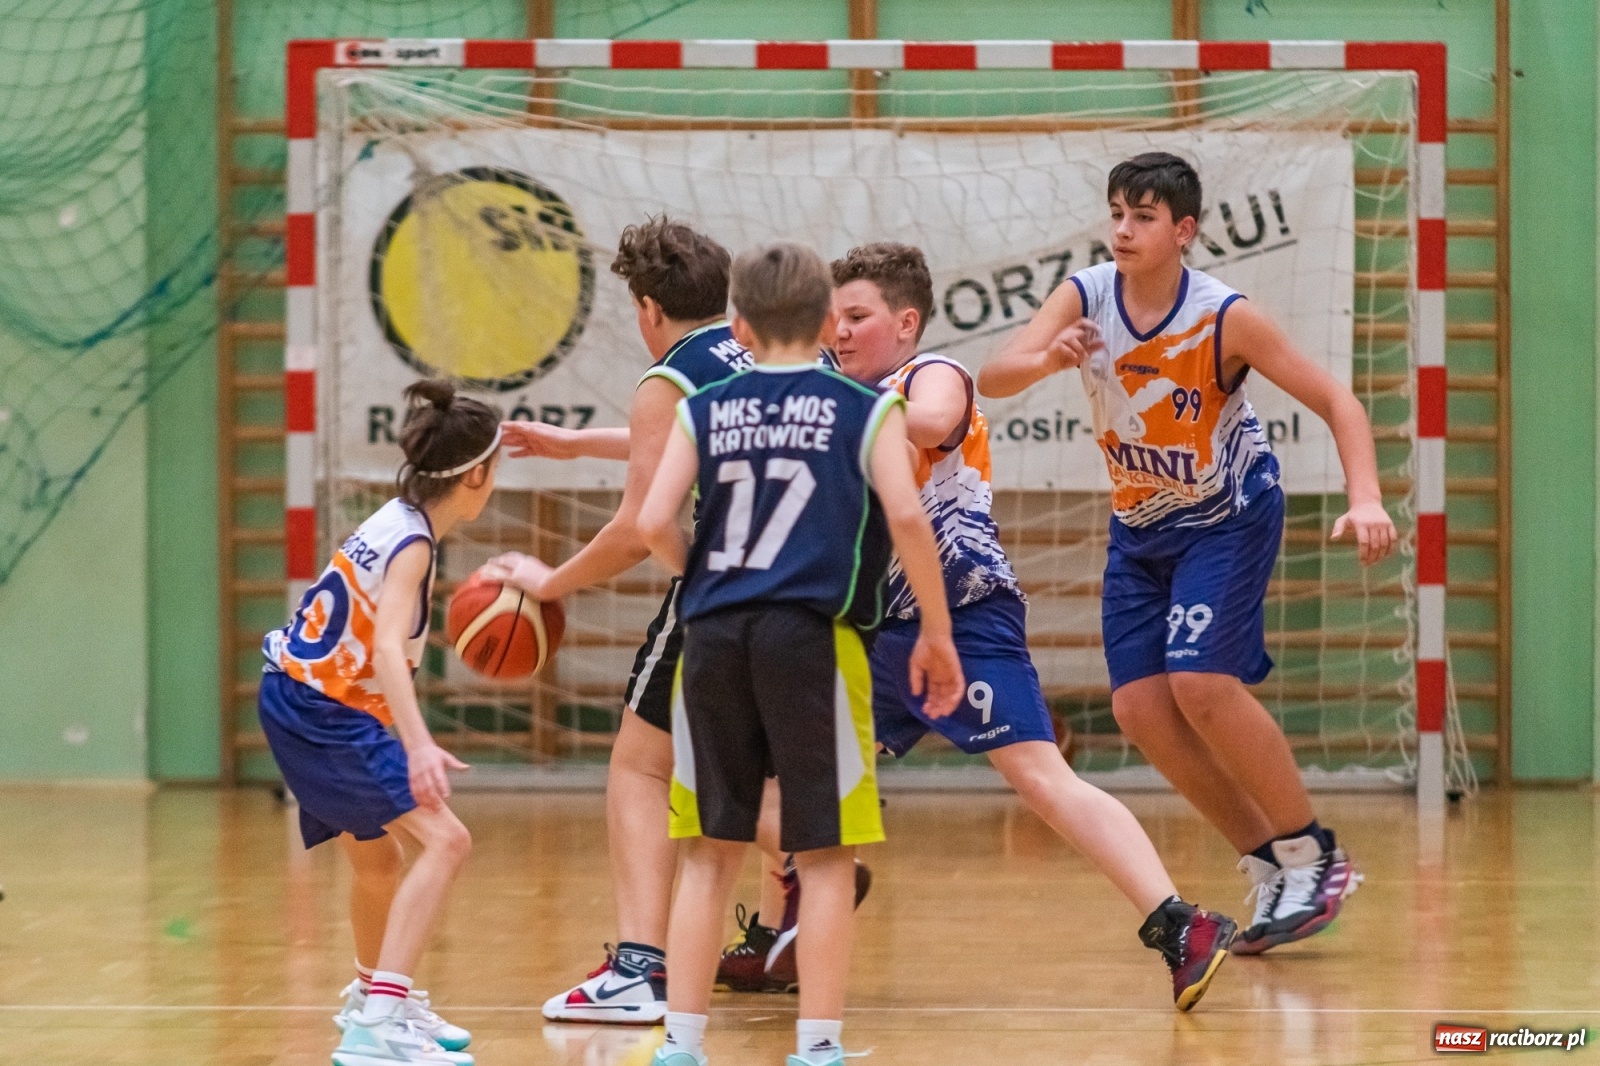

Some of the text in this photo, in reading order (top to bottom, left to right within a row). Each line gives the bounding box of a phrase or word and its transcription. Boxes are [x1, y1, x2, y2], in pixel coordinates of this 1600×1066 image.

[709, 397, 763, 431] MKS
[781, 394, 837, 426] MOS
[1171, 386, 1203, 423] 99
[709, 423, 833, 457] KATOWICE
[1105, 441, 1198, 485] MINI
[707, 458, 818, 572] 17
[1165, 603, 1213, 645] 99
[967, 680, 994, 724] 9
[969, 724, 1011, 742] regio
